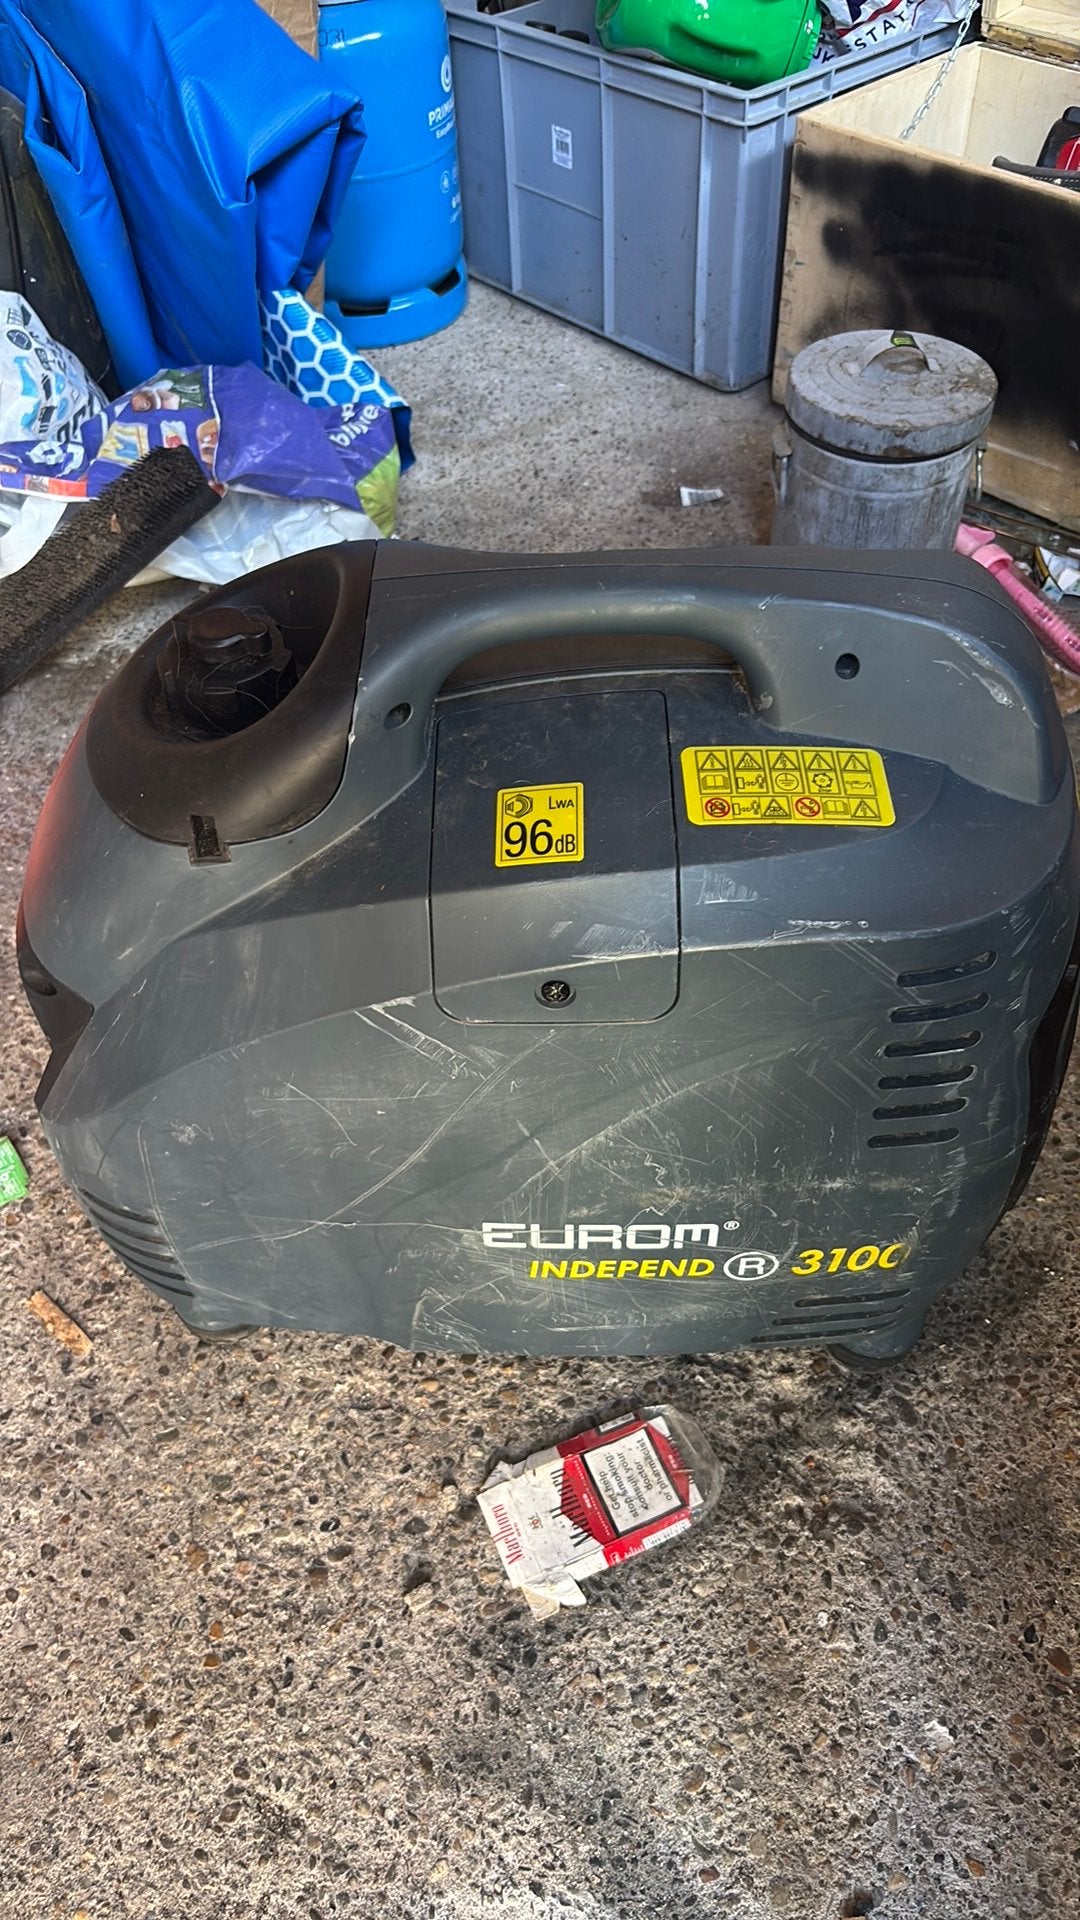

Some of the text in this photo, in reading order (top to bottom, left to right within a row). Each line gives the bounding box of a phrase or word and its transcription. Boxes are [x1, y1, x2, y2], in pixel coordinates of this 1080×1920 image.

[529, 1258, 715, 1280] INDEPEND
[602, 1451, 629, 1496] smoking:
[615, 1450, 632, 1473] your
[633, 1459, 653, 1491] doctor
[636, 1436, 667, 1490] pharmacist
[596, 1469, 614, 1492] help
[626, 1473, 648, 1509] consult
[662, 1491, 672, 1502] or
[549, 1467, 594, 1548] Marlboro
[623, 1495, 640, 1518] stop
[491, 1503, 525, 1565] Marlboro
